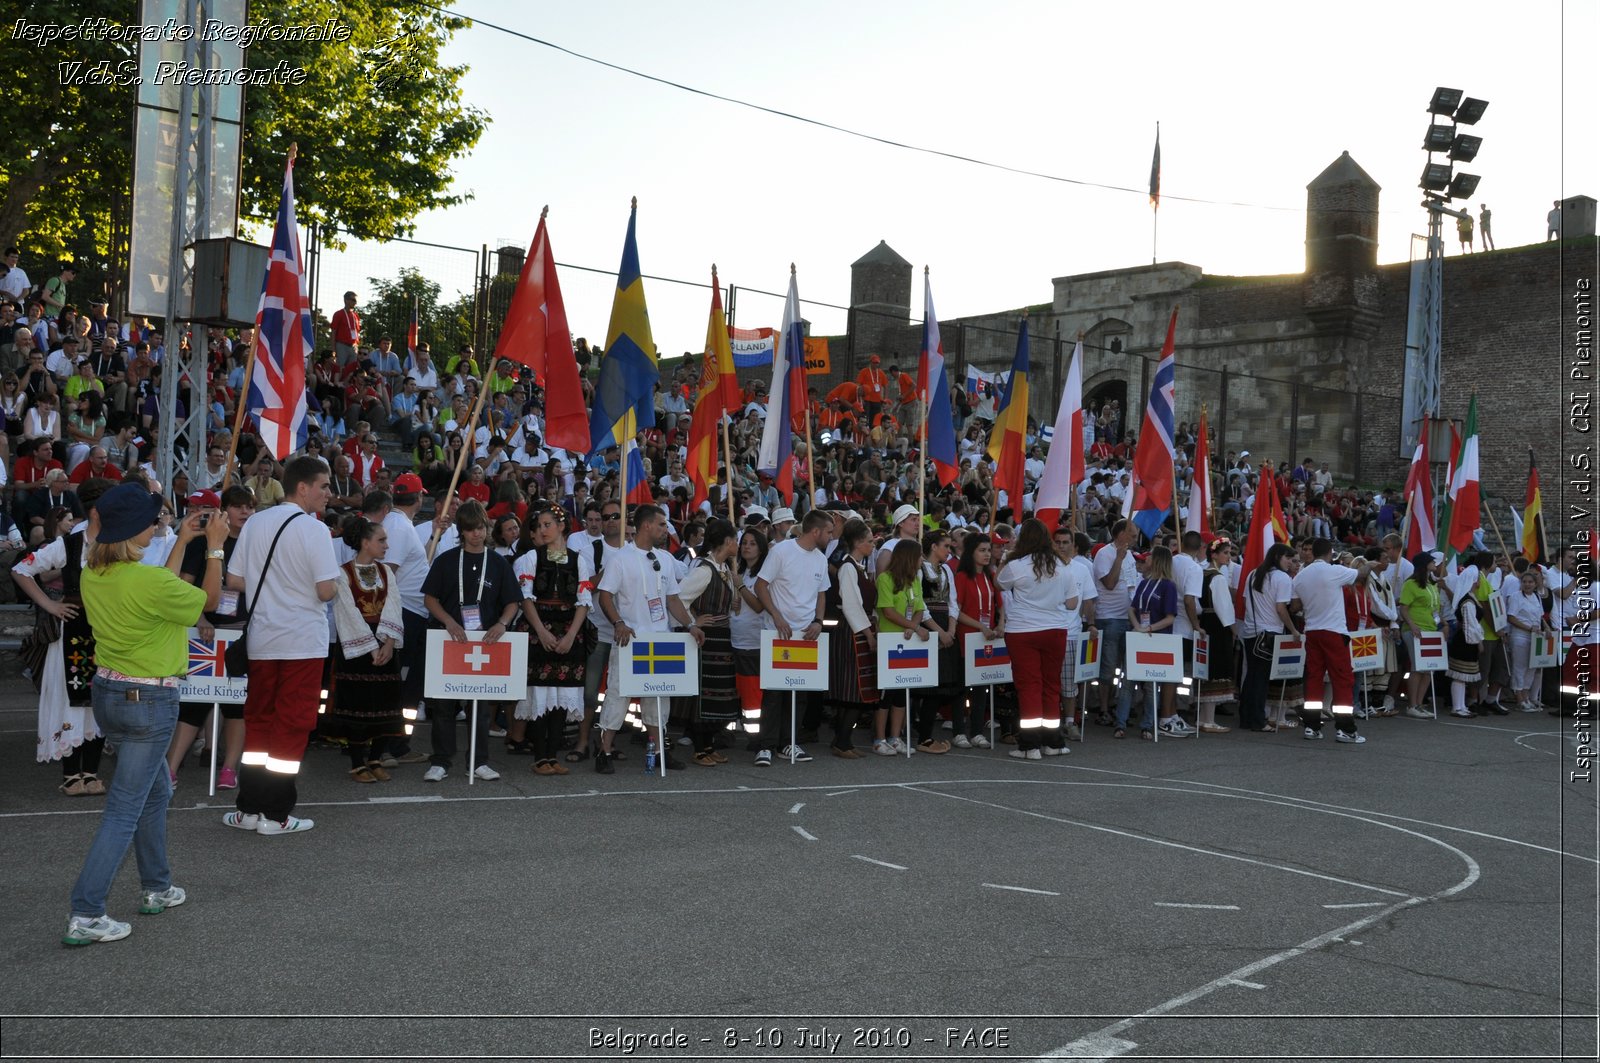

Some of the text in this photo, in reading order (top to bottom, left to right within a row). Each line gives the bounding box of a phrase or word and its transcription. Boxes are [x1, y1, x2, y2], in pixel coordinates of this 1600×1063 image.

[731, 341, 766, 352] OLLAND
[980, 671, 1005, 680] Slovakia
[1145, 669, 1167, 678] Poland
[784, 676, 806, 686] Spain
[895, 675, 922, 684] Slovenia
[214, 685, 248, 699] Kingd
[444, 682, 507, 694] Switzerland
[643, 682, 676, 692] Sweden
